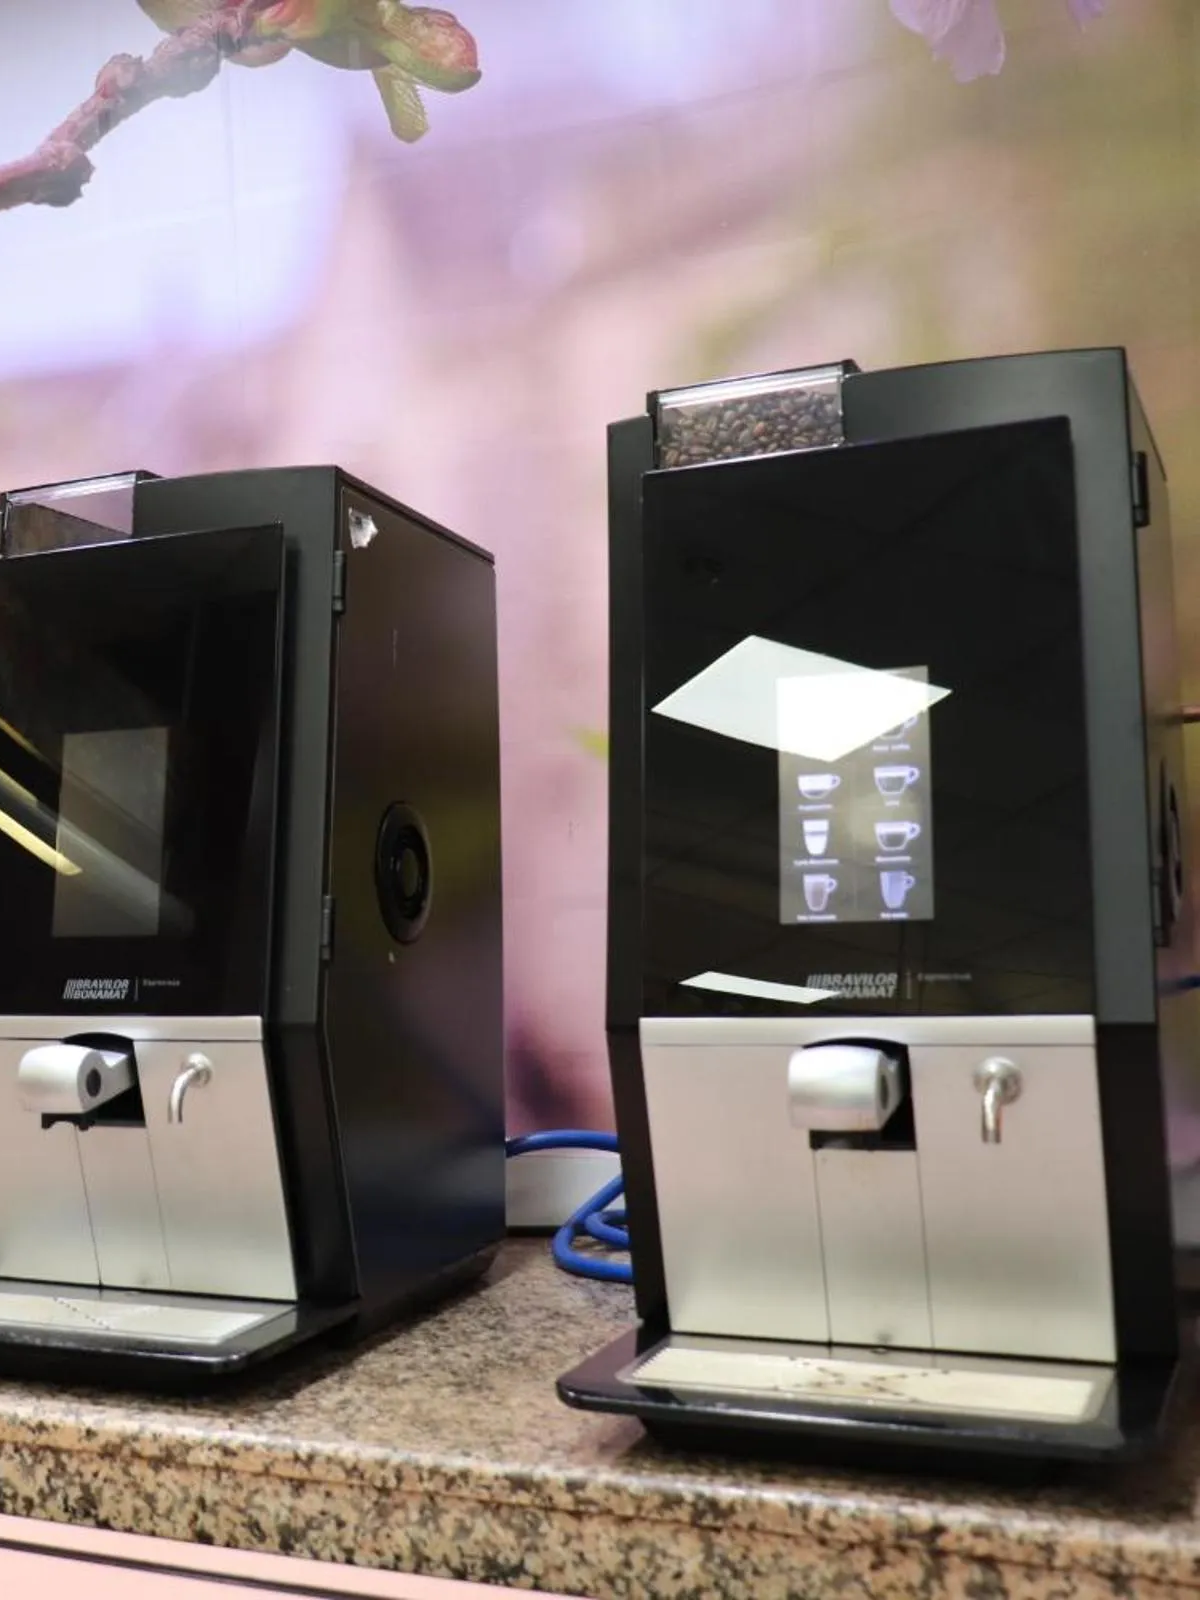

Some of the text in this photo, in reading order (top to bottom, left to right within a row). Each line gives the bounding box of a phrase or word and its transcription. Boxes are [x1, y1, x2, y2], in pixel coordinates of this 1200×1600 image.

[73, 978, 130, 989] BRAVILOR
[821, 972, 899, 986] BRAVILOR
[73, 989, 128, 1000] BONAMAT
